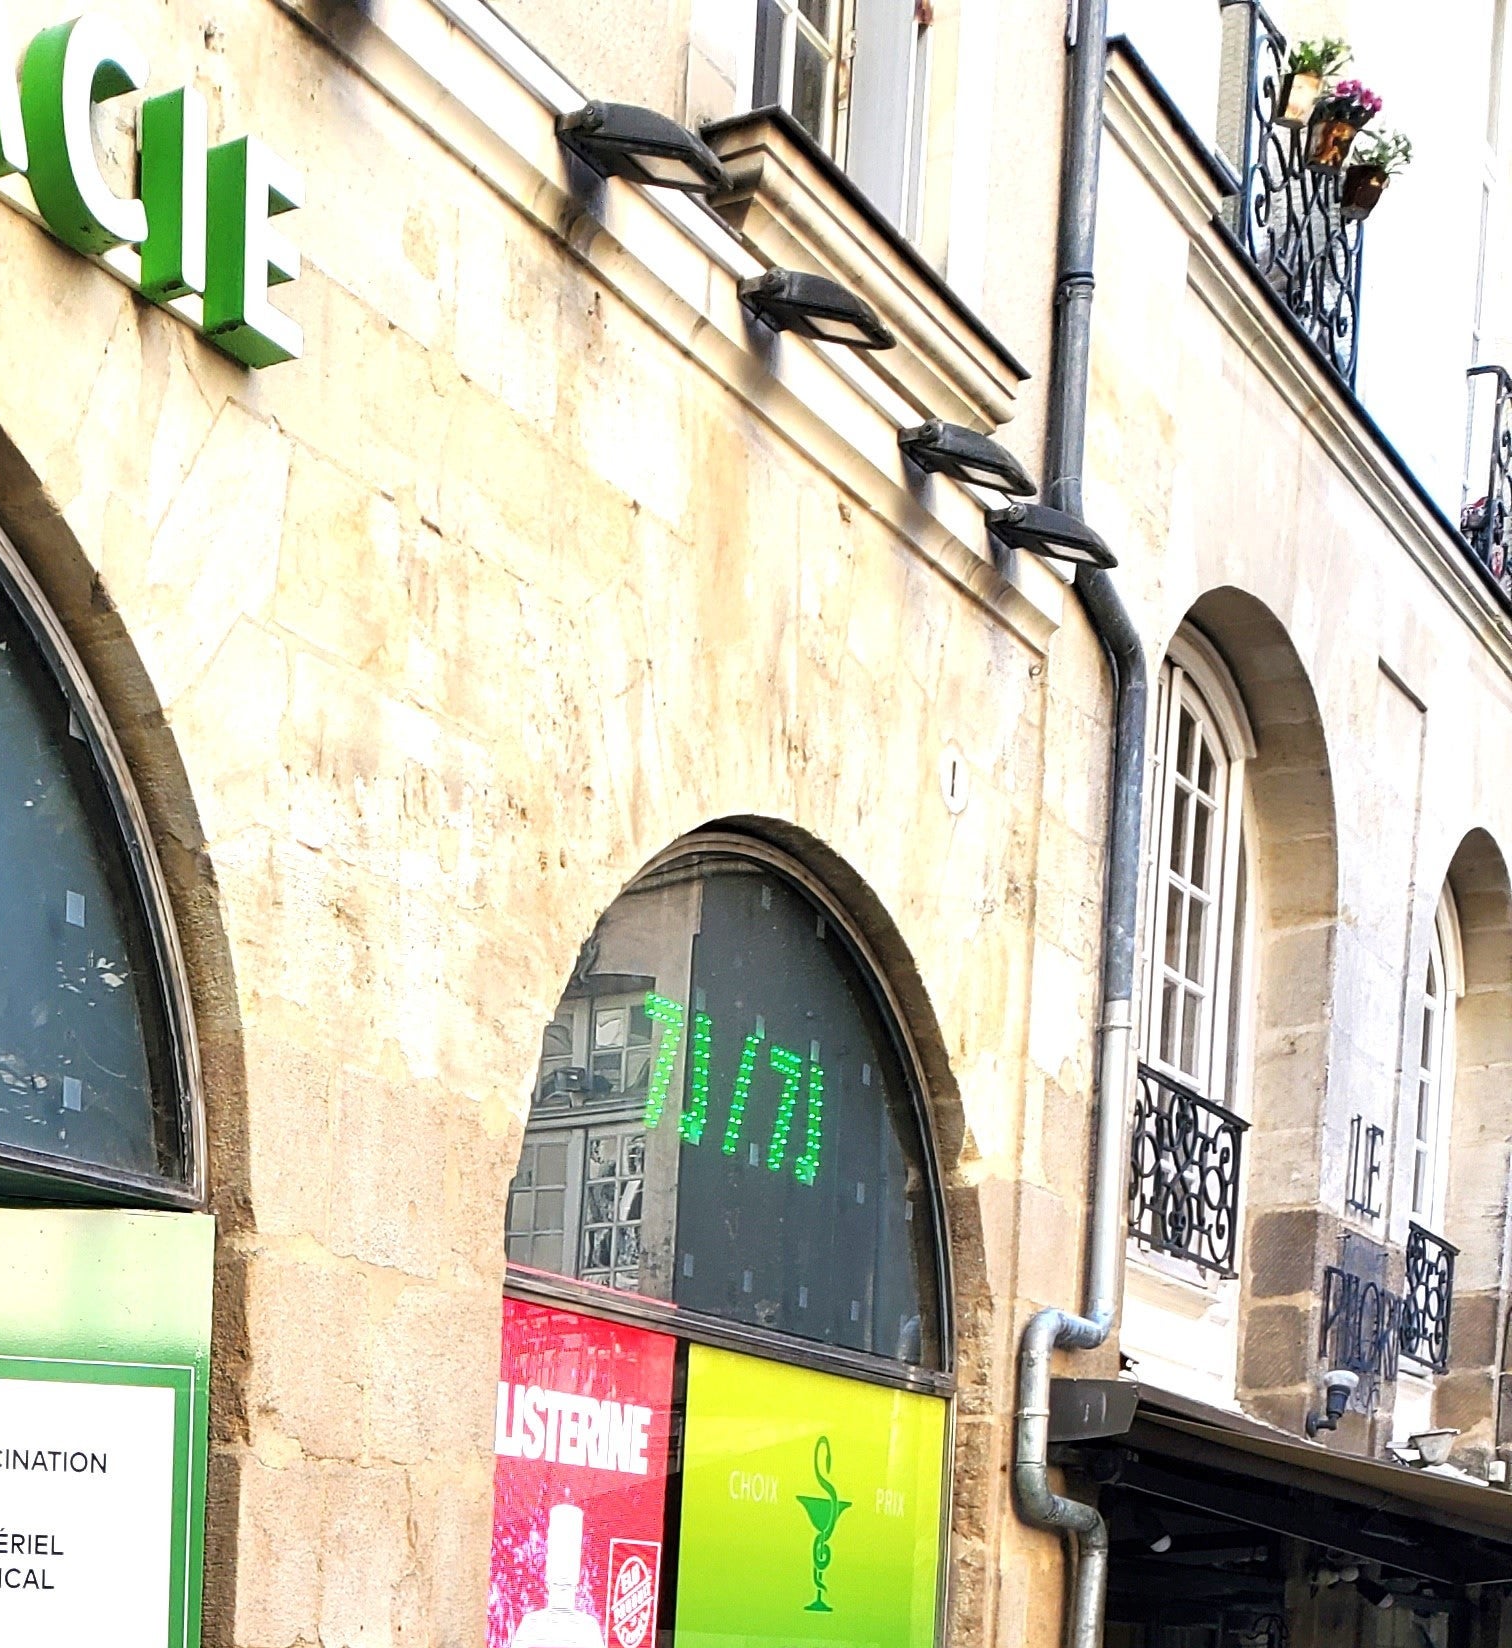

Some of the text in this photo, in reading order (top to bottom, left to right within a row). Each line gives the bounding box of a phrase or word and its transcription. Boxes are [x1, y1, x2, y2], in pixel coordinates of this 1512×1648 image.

[494, 1380, 654, 1476] LISTERINE
[729, 1470, 905, 1518] CHOIX PRIX
